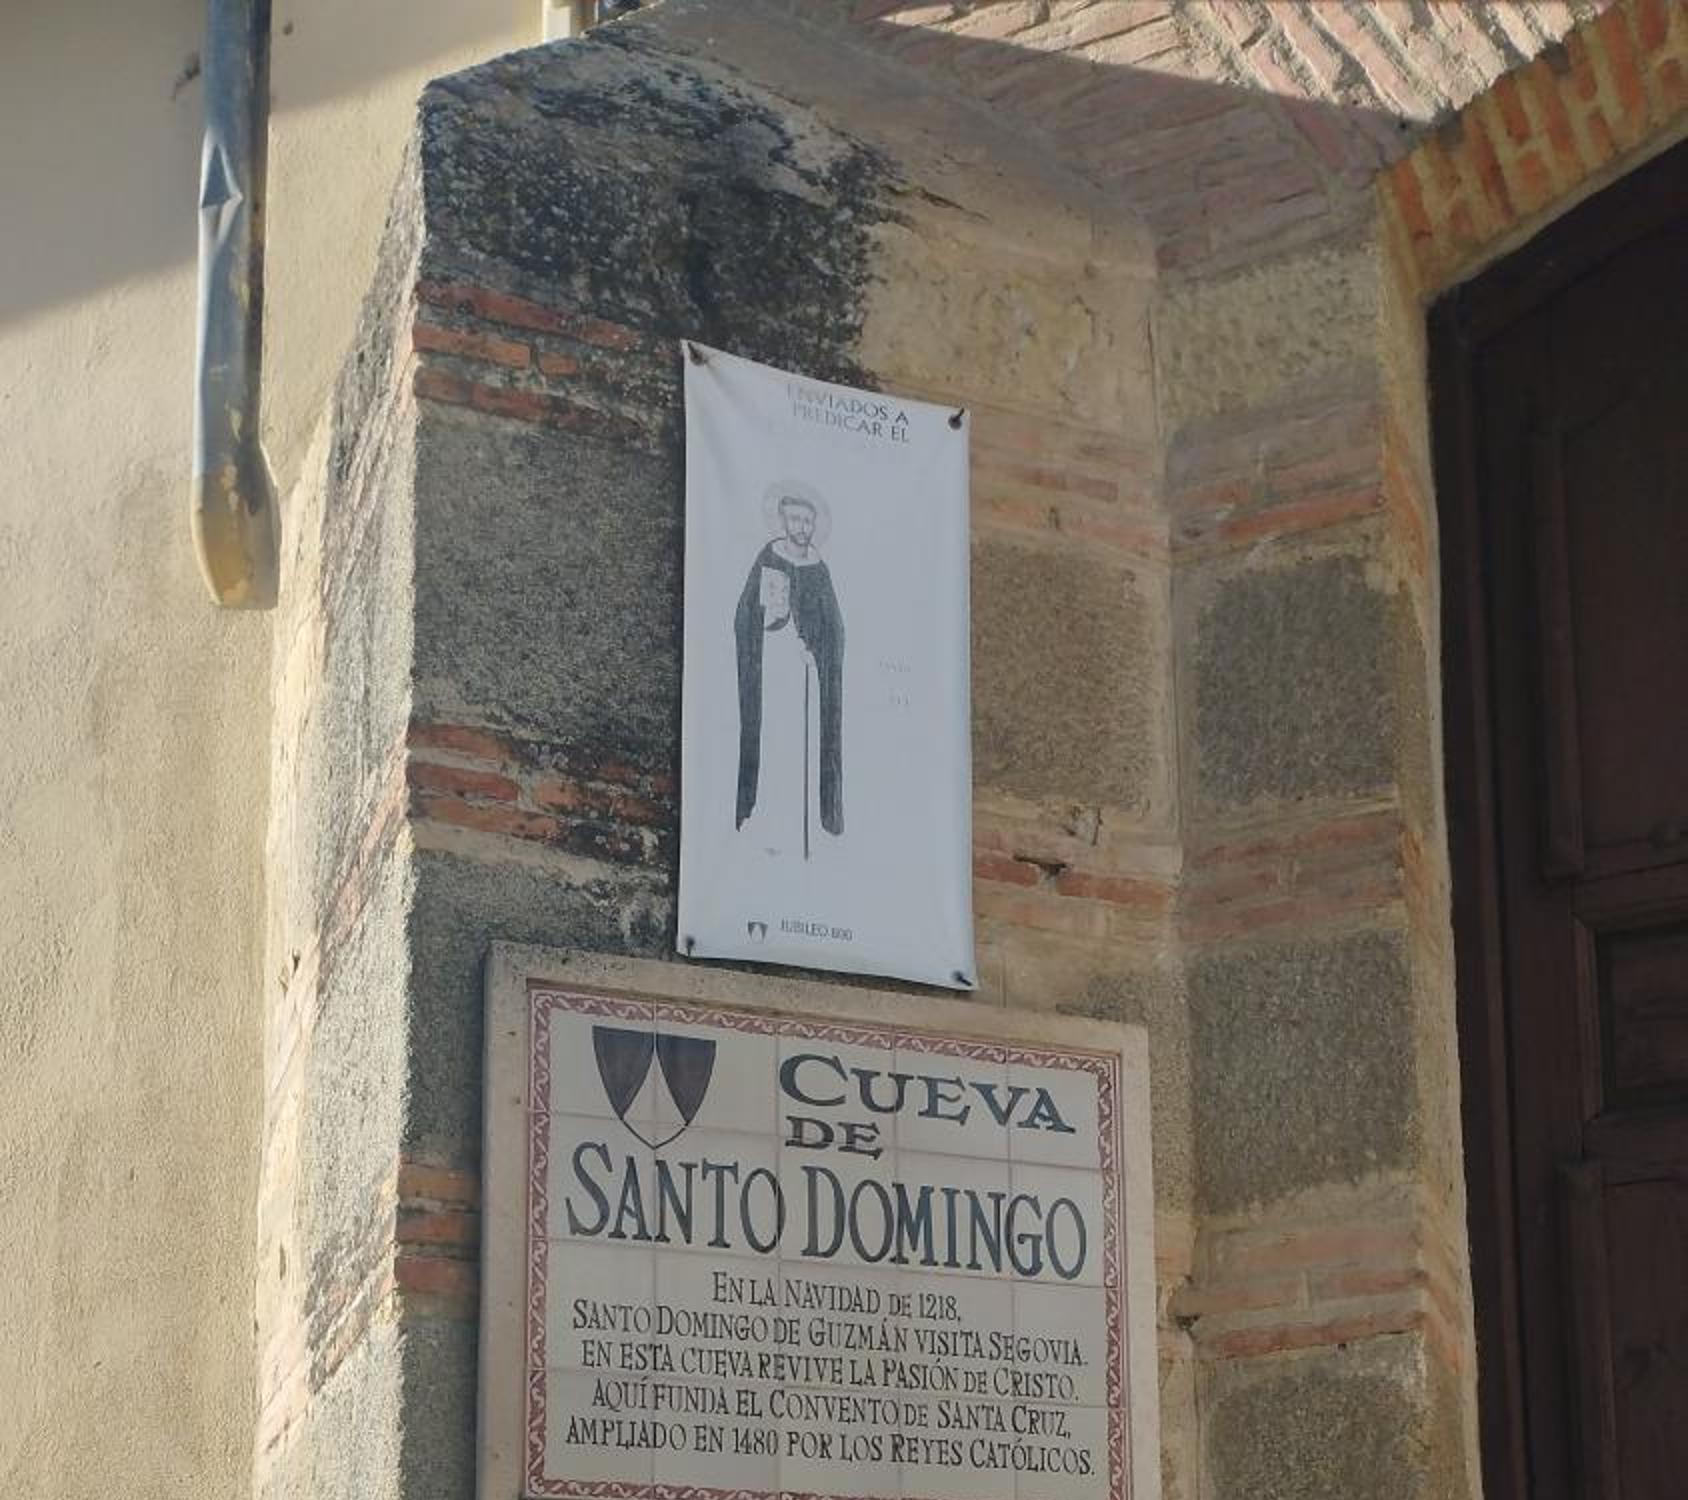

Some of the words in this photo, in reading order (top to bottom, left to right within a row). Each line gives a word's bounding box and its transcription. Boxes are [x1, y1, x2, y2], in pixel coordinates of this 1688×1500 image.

[793, 399, 883, 437] PREDICAR
[891, 425, 909, 442] EL
[895, 410, 909, 425] A
[779, 1053, 1076, 1135] CUEVA
[785, 1115, 883, 1161] DE
[565, 1141, 786, 1254] SANTO
[800, 1165, 1087, 1281] DOMINGO
[713, 1271, 744, 1304] EN
[749, 1278, 776, 1306] LA
[785, 1279, 881, 1314] NAVIDAD
[888, 1293, 911, 1318] DE
[919, 1293, 961, 1322] 1218,
[573, 1298, 650, 1333] SANTO
[656, 1304, 769, 1343] DOMINGO
[773, 1316, 800, 1345] DE
[809, 1317, 908, 1352] GUZMÁN
[914, 1328, 986, 1359] VISITA
[989, 1331, 1088, 1366] SEGOVIA.
[582, 1339, 613, 1368] EN
[620, 1342, 675, 1372] ESTA
[682, 1347, 753, 1378] CUEVA
[758, 1353, 843, 1385] REVIVE
[850, 1358, 876, 1386] LA
[882, 1357, 957, 1391] PASIÓN
[963, 1370, 987, 1394] DE
[993, 1367, 1079, 1401] CRISTO.
[591, 1376, 648, 1412] AQUÍ
[652, 1383, 729, 1415] FUNDA
[736, 1389, 763, 1418] EL
[769, 1389, 899, 1424] CONVENTO
[904, 1402, 929, 1428] DE
[937, 1400, 1006, 1432] SANTA
[1011, 1405, 1071, 1439] CRUZ,
[566, 1415, 686, 1451] AMPLIADO
[693, 1425, 724, 1453] EN
[733, 1427, 778, 1456] 1480
[787, 1431, 832, 1460] POR
[840, 1434, 883, 1462] LOS
[890, 1433, 963, 1467] REYES
[970, 1437, 1095, 1476] CATÓLICOS.
